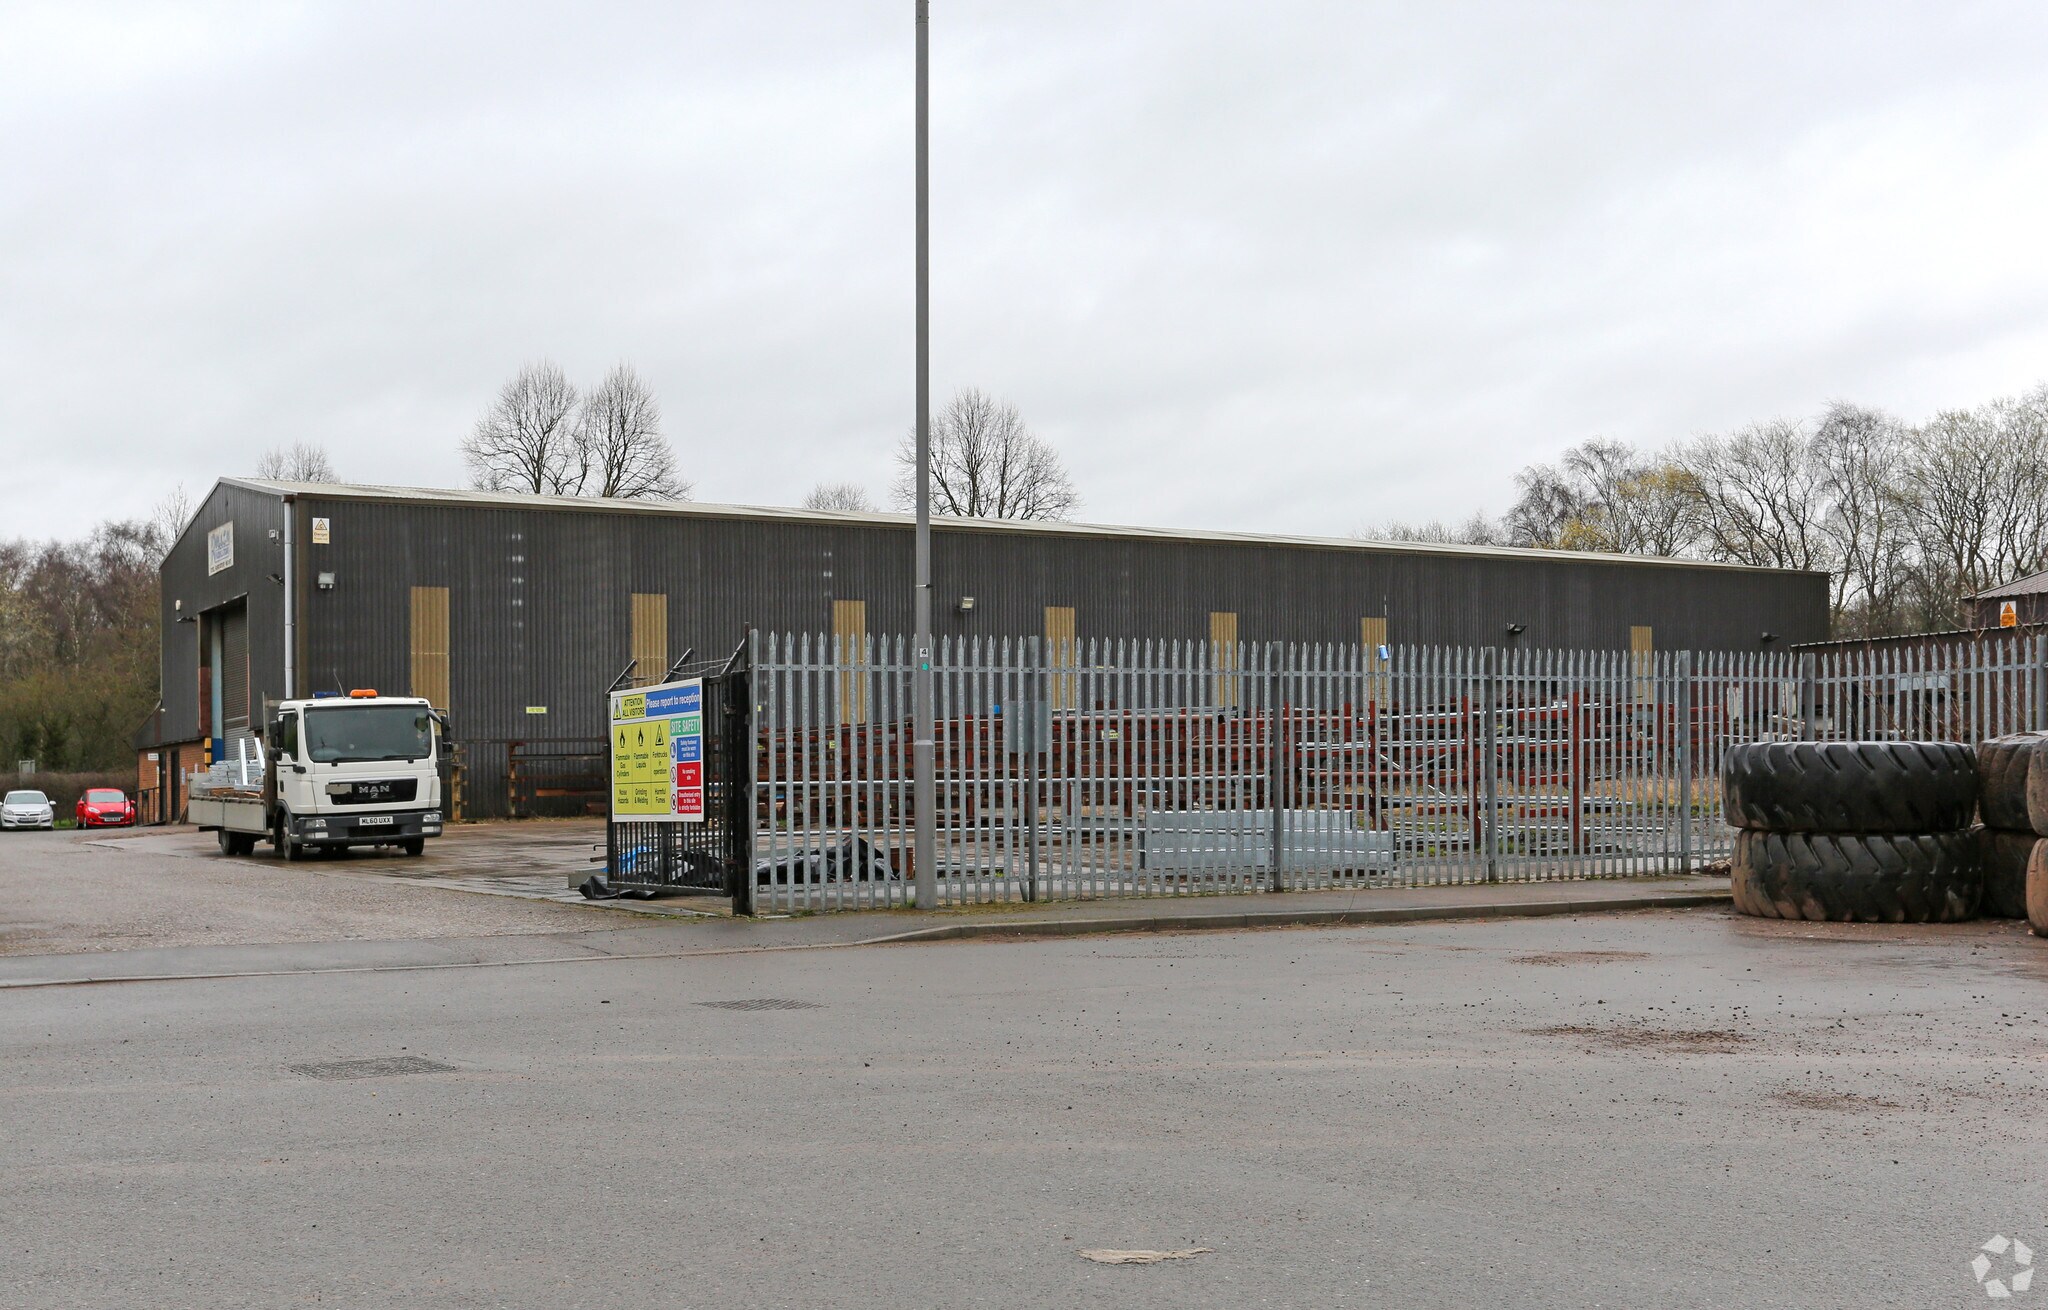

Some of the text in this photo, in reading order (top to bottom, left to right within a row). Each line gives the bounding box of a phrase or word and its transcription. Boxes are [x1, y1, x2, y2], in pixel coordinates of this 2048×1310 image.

[624, 697, 643, 707] ATTENTION
[646, 692, 700, 709] Please report to reception
[630, 706, 645, 716] VISITORS
[671, 718, 700, 734] SITE SAFETY
[634, 752, 648, 760] Flammable
[616, 770, 630, 778] Cylinders
[635, 788, 647, 796] Grinding
[637, 796, 648, 805] Welding
